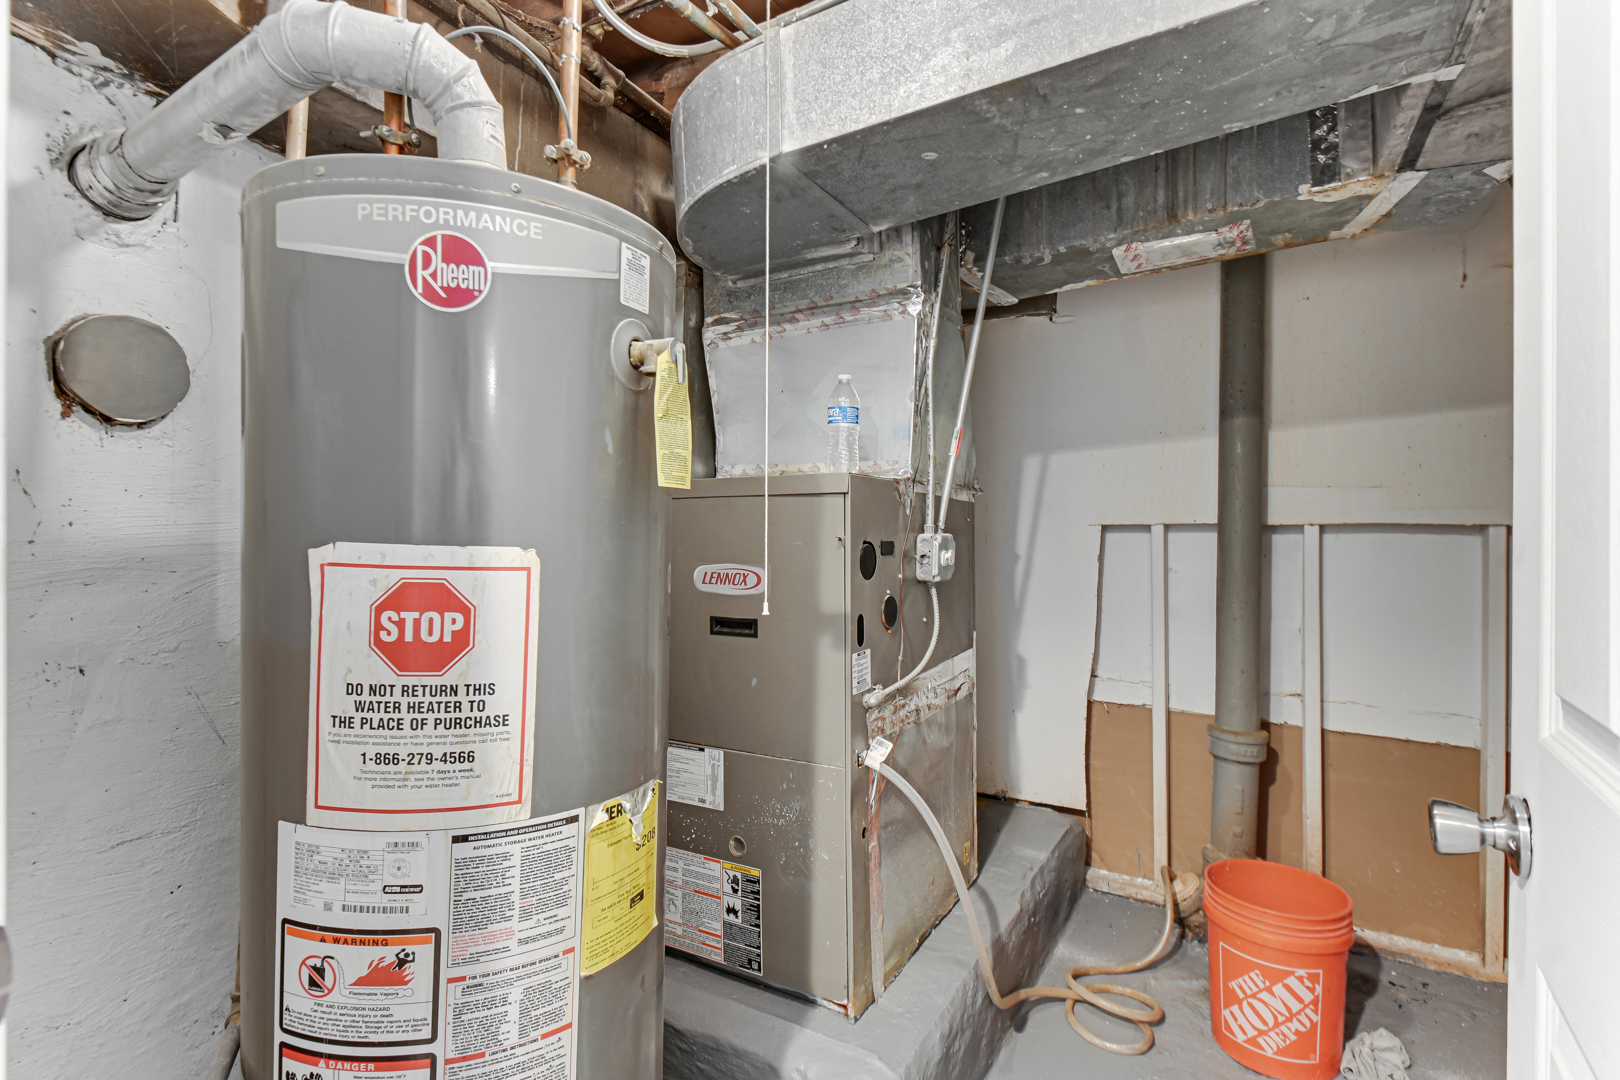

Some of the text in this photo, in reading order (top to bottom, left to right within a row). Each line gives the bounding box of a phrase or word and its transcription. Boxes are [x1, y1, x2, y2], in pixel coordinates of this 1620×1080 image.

[357, 203, 543, 240] PERFORMANCE
[416, 234, 485, 298] Rheem
[702, 571, 750, 586] LENNOX
[379, 610, 465, 643] STOP
[345, 682, 496, 698] DO NOT RETURN THIS
[354, 700, 486, 714] WATER HEATER TO
[330, 714, 510, 731] THE PLACE OF PURCHASE
[360, 750, 476, 766] 1-866-279-4566
[360, 768, 392, 776] Technicians
[468, 820, 566, 841] INSTALLATION AND OPERATION DETAILS
[472, 842, 504, 850] AUTOMATIC
[528, 835, 544, 844] WATER
[545, 830, 563, 838] HEATER
[332, 936, 389, 946] WARNING
[522, 962, 538, 970] BEFORE
[538, 954, 560, 964] OPERATING
[1228, 969, 1270, 999] THE
[1223, 970, 1321, 1042] HOME
[1256, 1004, 1320, 1055] DEPOT
[488, 1038, 539, 1057] LIGHTING INSTRUCTIONS
[328, 1060, 375, 1072] DANGER
